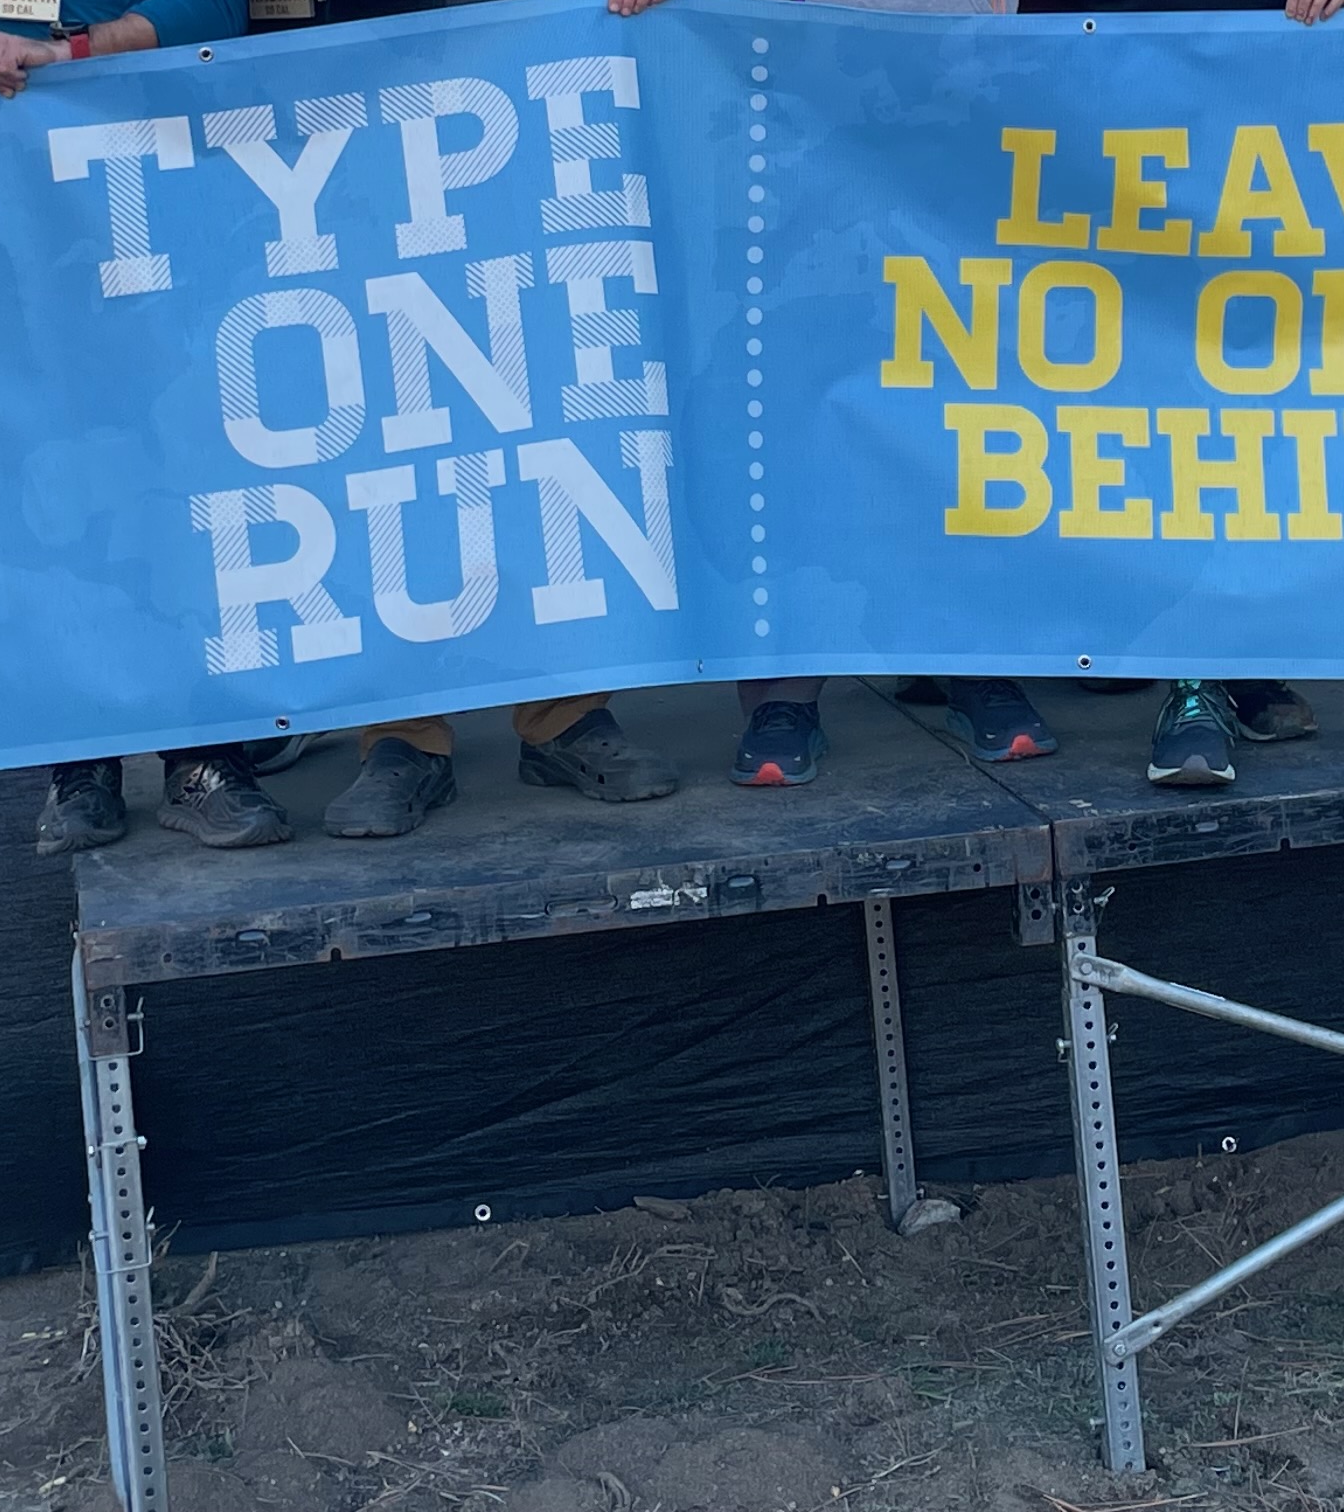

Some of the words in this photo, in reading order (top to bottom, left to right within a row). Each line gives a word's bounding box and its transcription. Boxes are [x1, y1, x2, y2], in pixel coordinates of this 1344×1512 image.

[16, 4, 34, 15] CAL
[48, 55, 651, 298] TYPE
[215, 240, 669, 469] ONE
[881, 255, 1123, 393] NO
[189, 430, 679, 675] RUN
